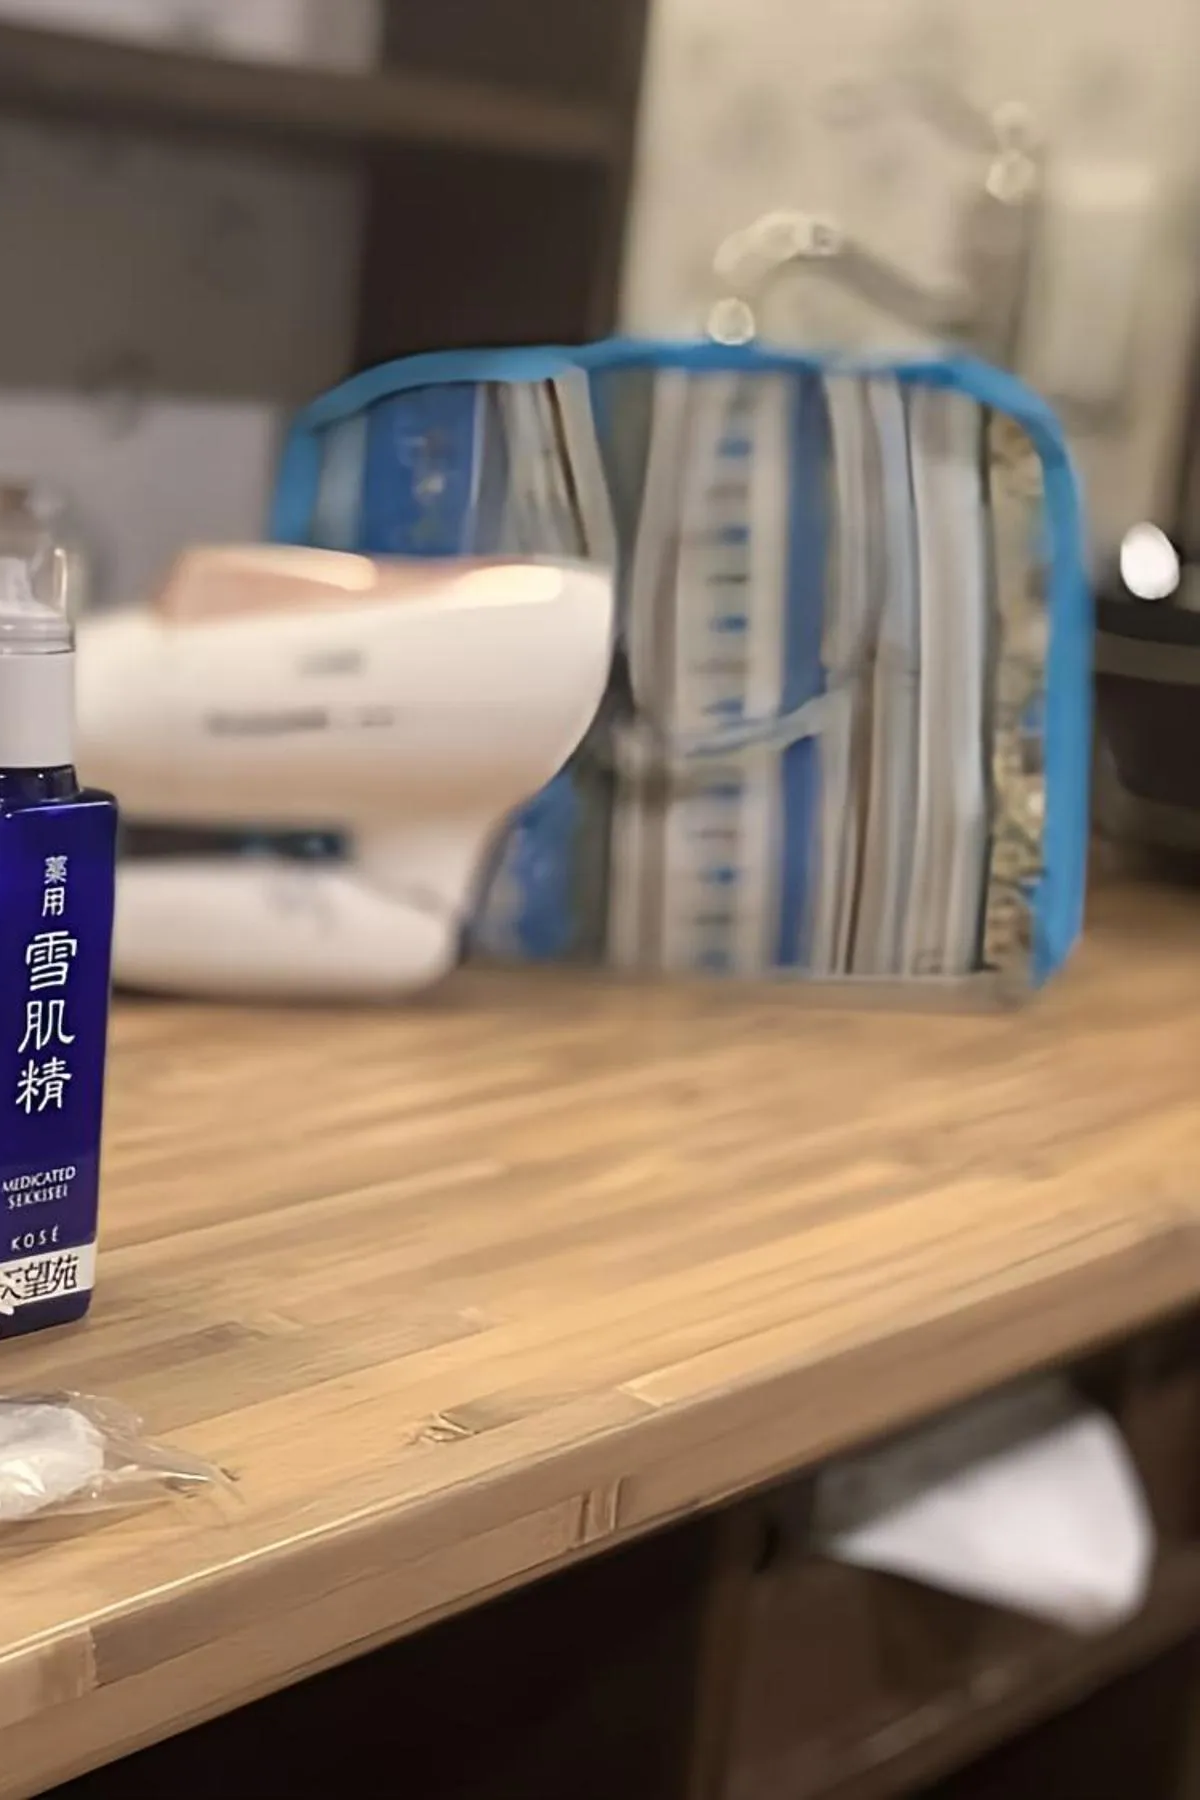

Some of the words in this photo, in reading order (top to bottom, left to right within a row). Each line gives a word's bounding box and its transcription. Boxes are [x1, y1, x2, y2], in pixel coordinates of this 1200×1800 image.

[15, 930, 78, 1114] 雪肌精
[2, 1165, 76, 1192] MEDICATED
[7, 1183, 68, 1210] SEKKISEI
